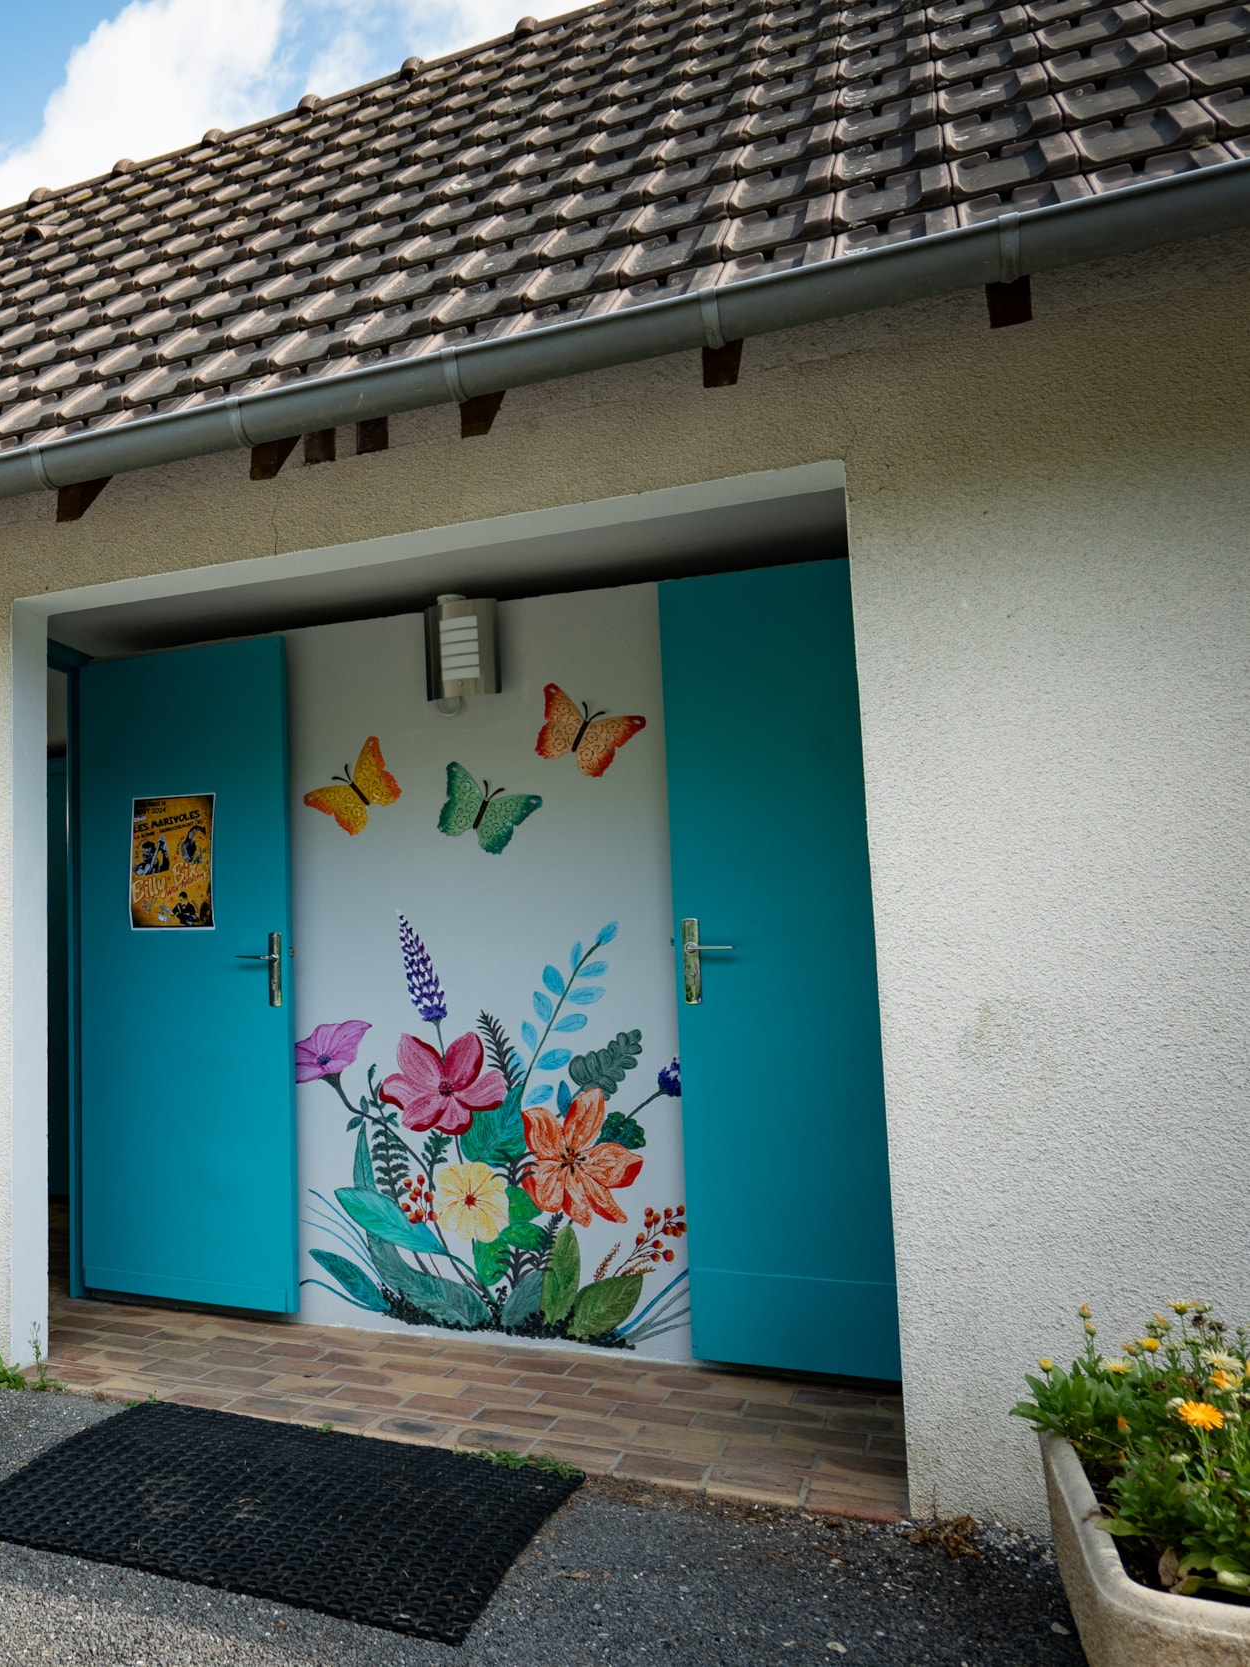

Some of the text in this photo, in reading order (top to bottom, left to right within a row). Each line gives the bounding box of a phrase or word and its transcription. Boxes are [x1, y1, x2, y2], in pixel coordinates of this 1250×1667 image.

[134, 809, 201, 833] LES MARIVOLES
[132, 861, 198, 903] Billy Bix
